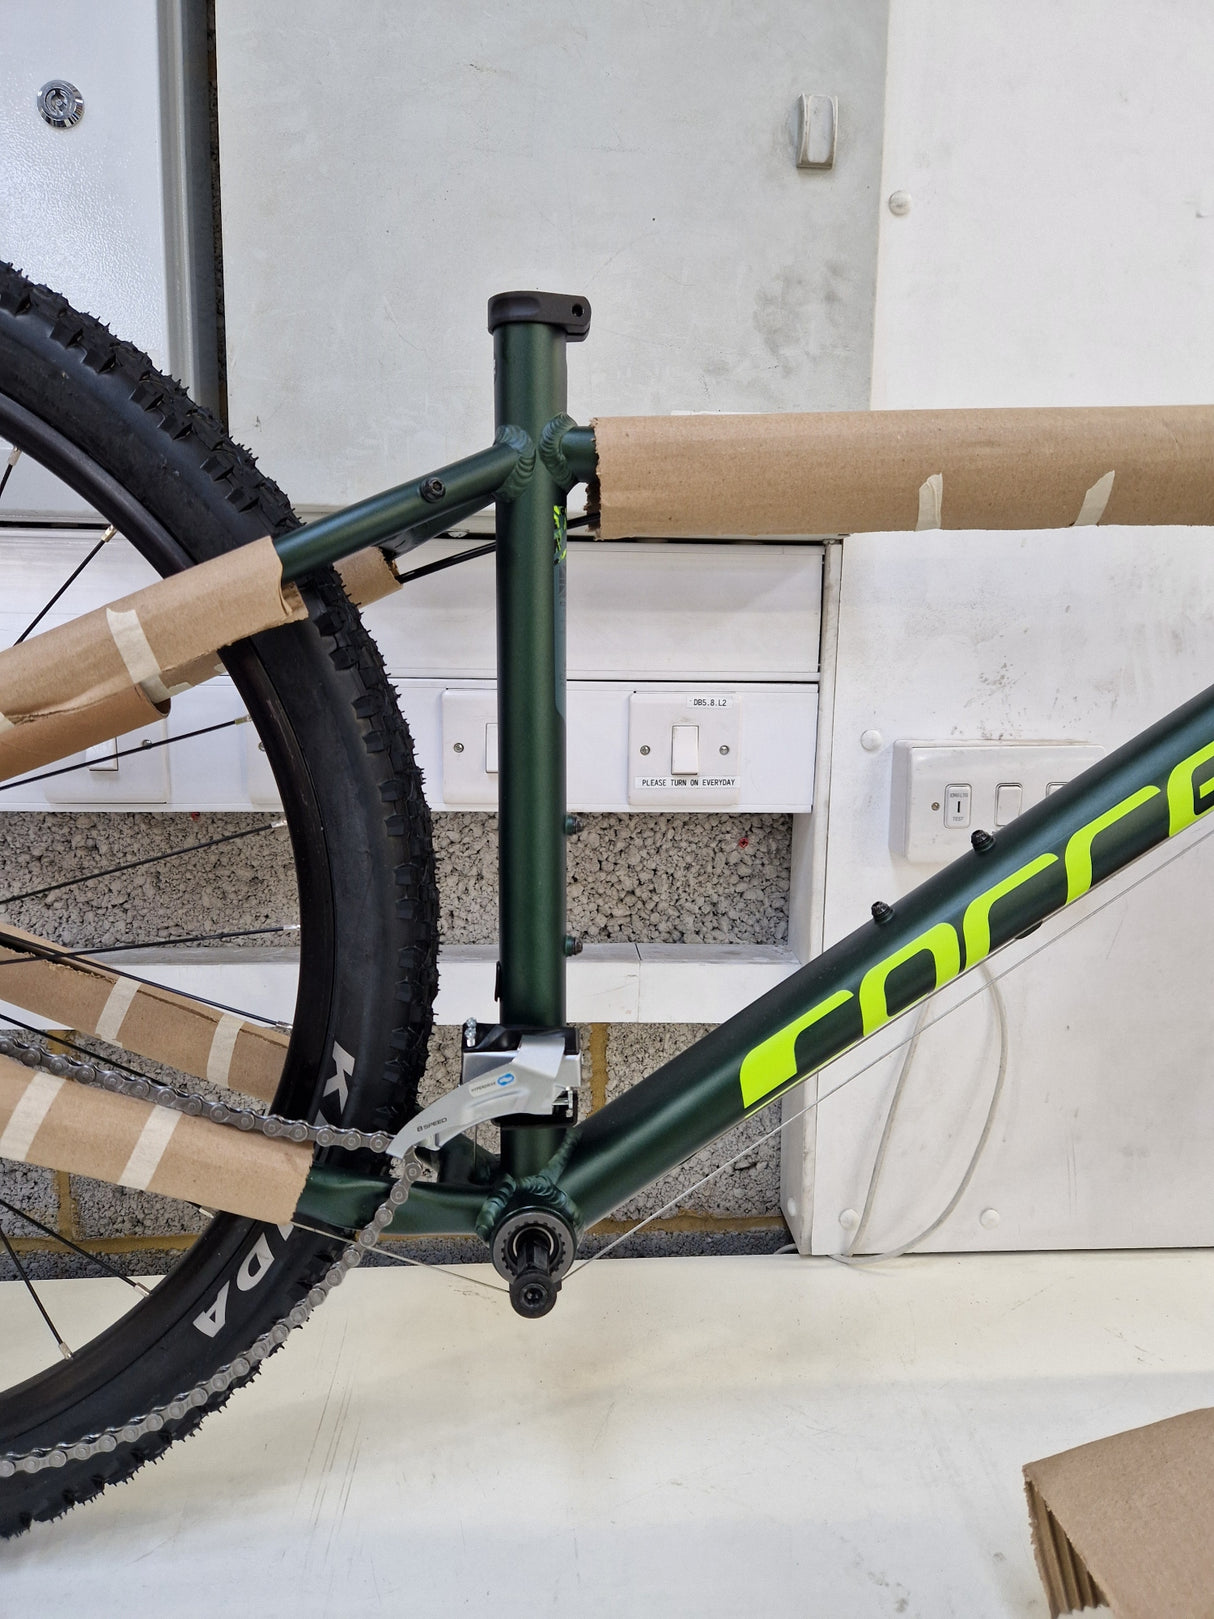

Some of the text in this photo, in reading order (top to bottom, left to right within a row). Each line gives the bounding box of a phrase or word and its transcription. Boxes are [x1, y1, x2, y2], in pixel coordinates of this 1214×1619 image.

[693, 698, 727, 707] DB5.8.L2
[642, 778, 735, 786] PLEASE TURN ON EVERYDAY
[423, 1117, 448, 1129] SPEED
[192, 1040, 356, 1339] KDA
